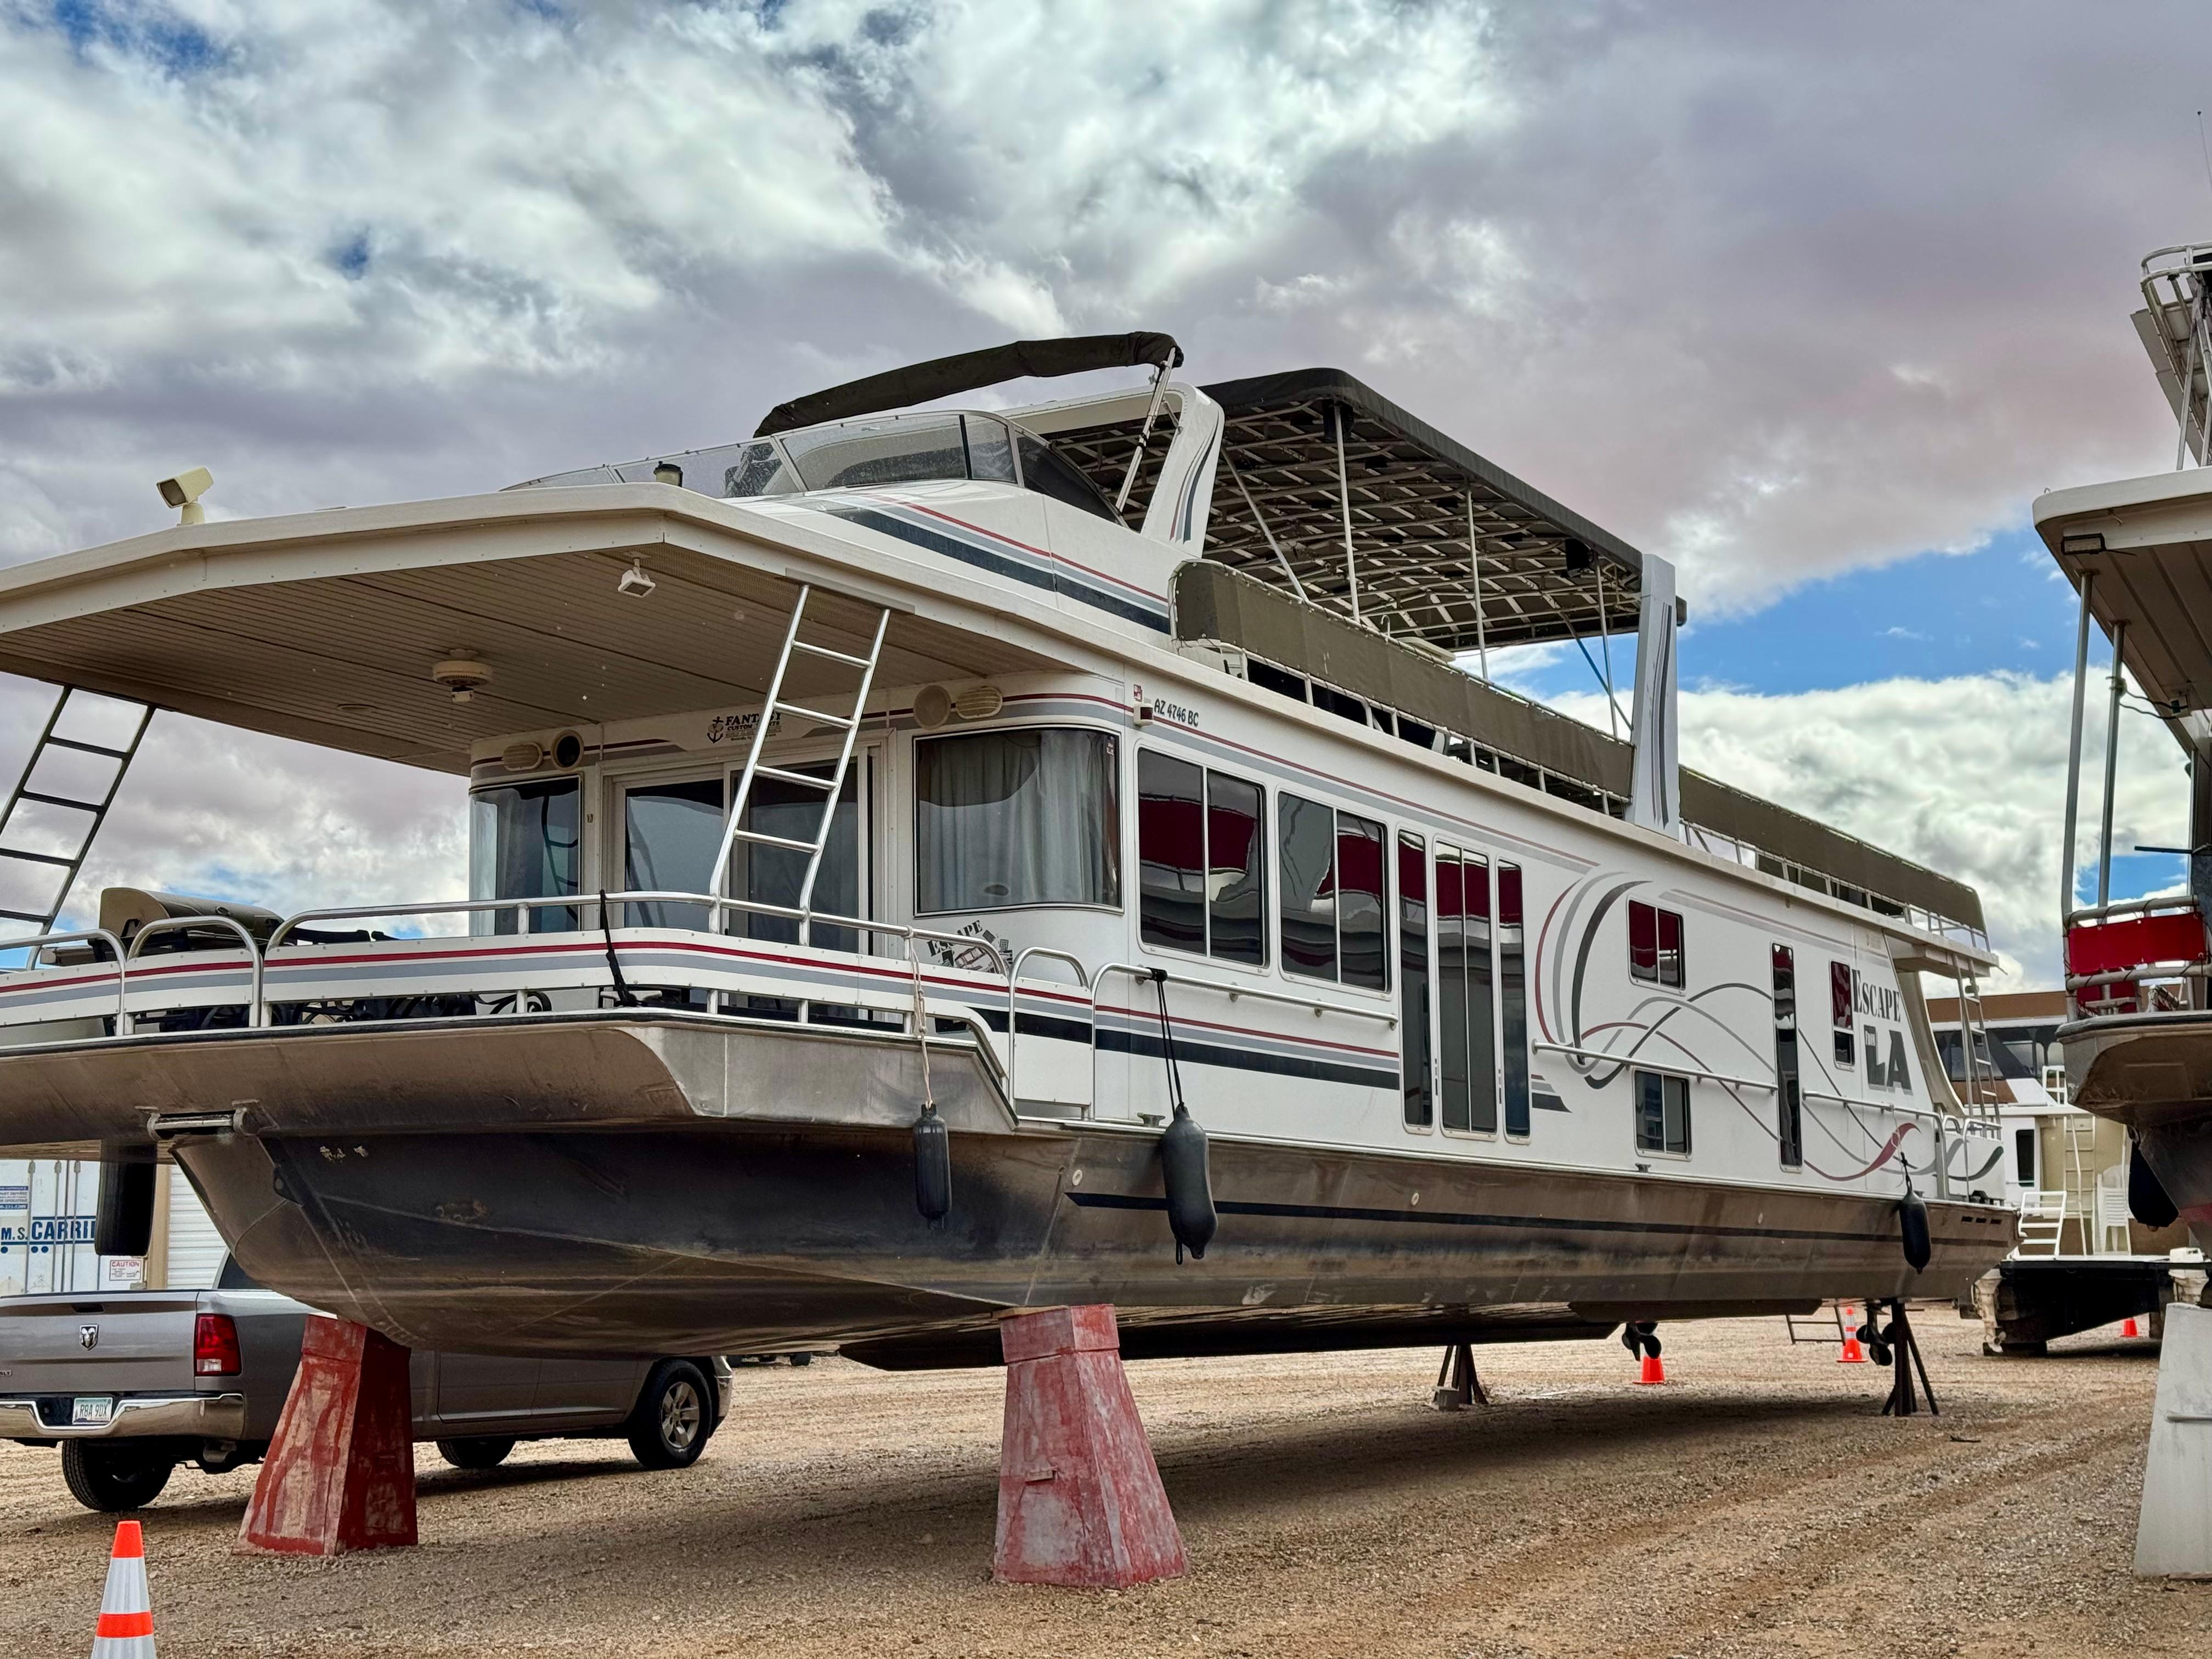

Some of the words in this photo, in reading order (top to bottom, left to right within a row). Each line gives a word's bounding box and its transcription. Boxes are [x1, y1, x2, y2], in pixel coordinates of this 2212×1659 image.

[1154, 698, 1166, 715] AZ
[1167, 703, 1186, 722] 4746
[1188, 710, 1199, 727] BC
[1852, 968, 1901, 1023] ESCAPE
[1864, 1024, 1914, 1096] LA
